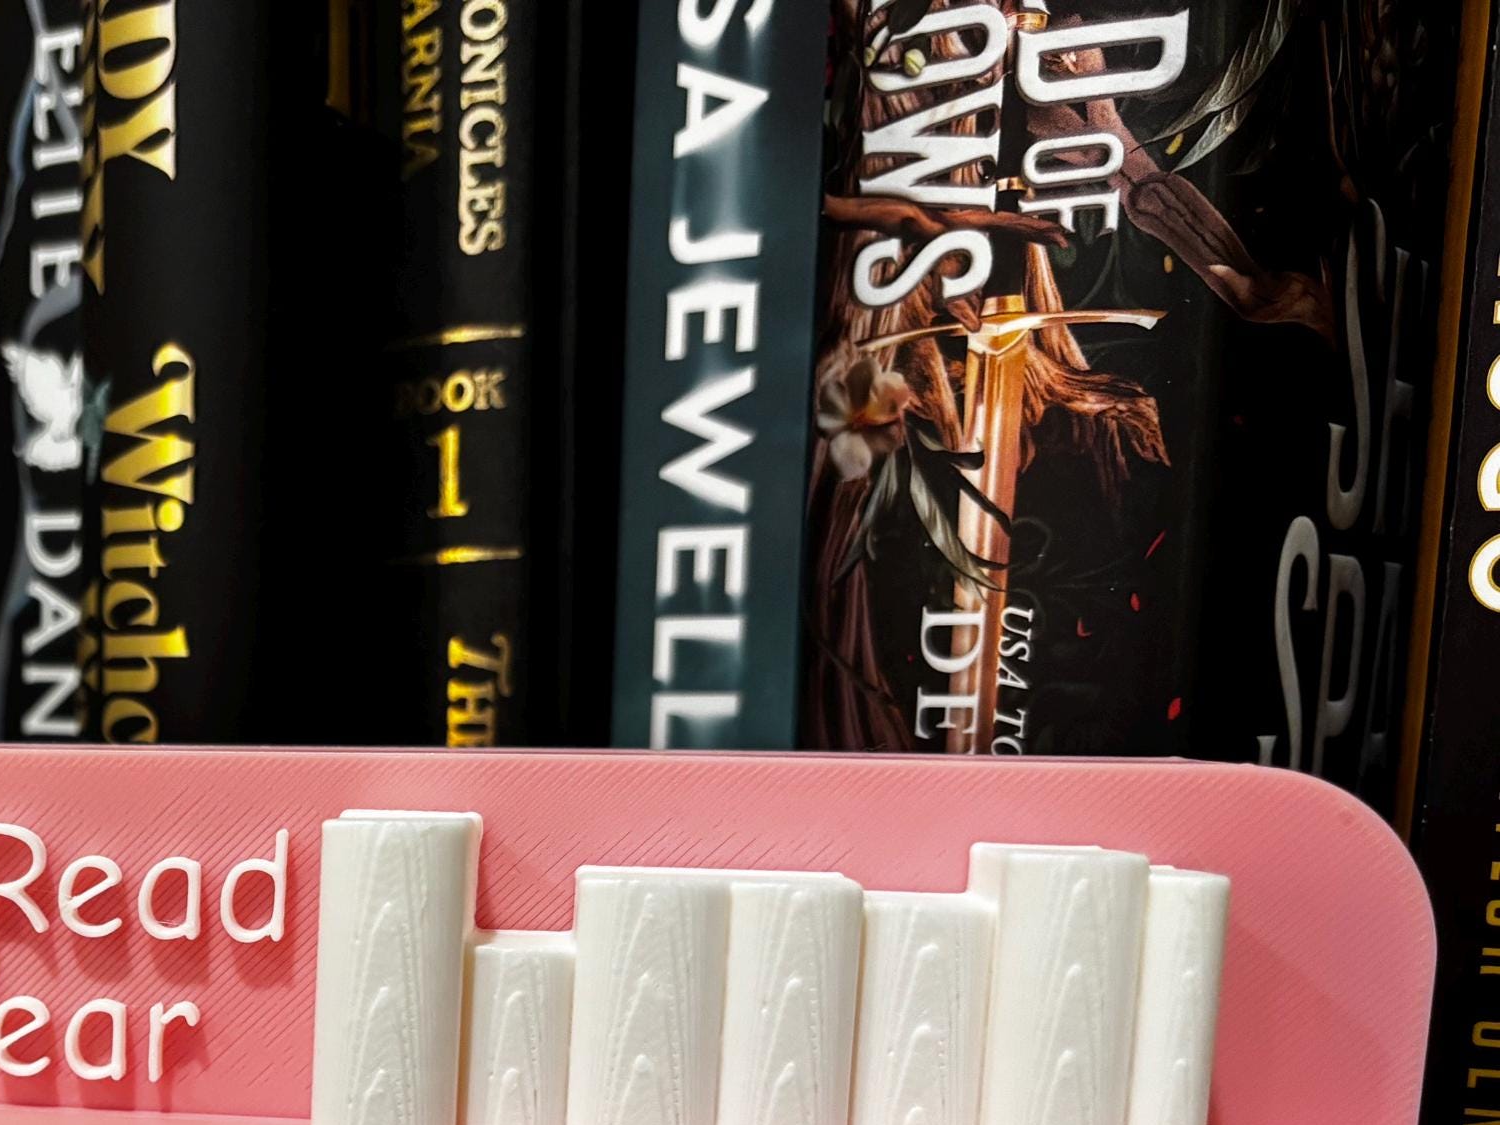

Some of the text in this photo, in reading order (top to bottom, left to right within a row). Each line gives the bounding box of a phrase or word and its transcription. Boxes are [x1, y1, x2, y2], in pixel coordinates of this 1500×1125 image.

[100, 0, 177, 181] DY
[853, 0, 1009, 308] OWS
[1015, 0, 1190, 237] D OF
[425, 423, 472, 520] 1
[650, 215, 762, 750] JEWELL
[915, 605, 986, 754] DE
[996, 606, 1033, 691] USA
